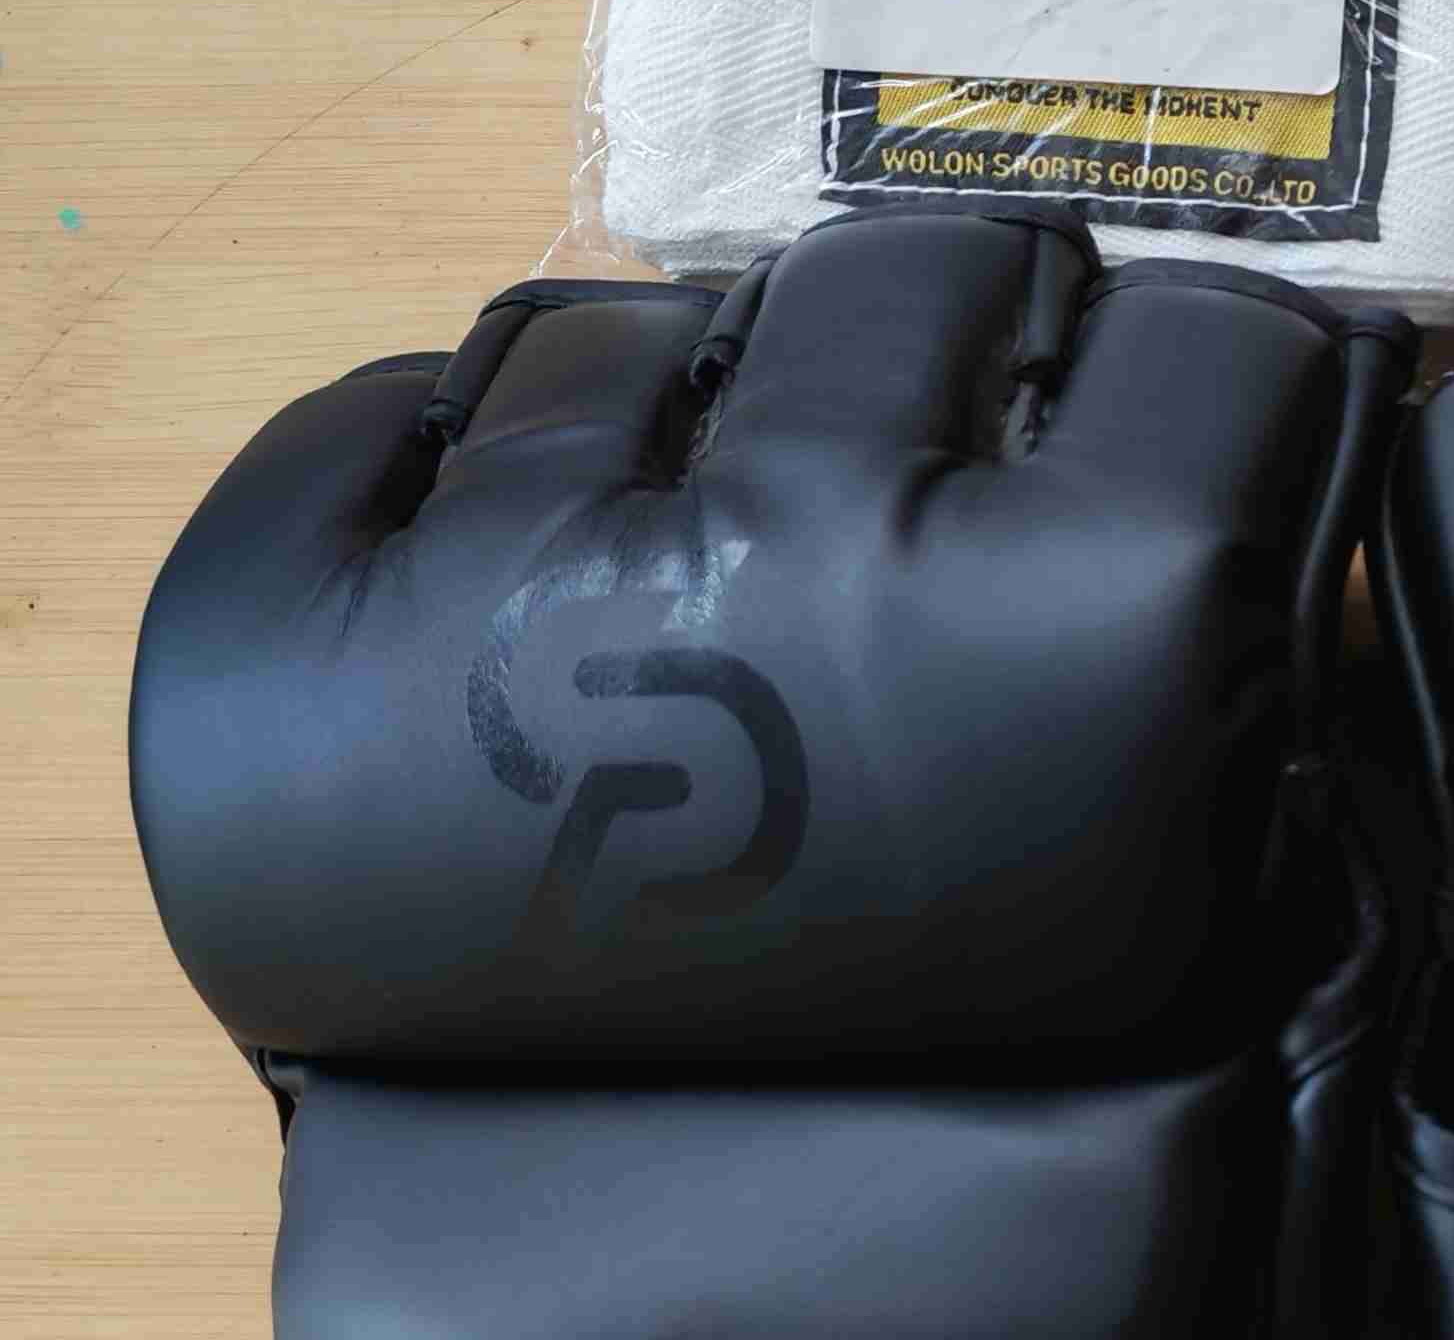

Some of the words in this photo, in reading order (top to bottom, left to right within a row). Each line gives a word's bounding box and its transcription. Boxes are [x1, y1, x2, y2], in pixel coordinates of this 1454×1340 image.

[1083, 87, 1137, 116] THE
[880, 147, 987, 176] WOLON
[989, 151, 1103, 187] SPORTS
[1107, 159, 1210, 193] GOODS
